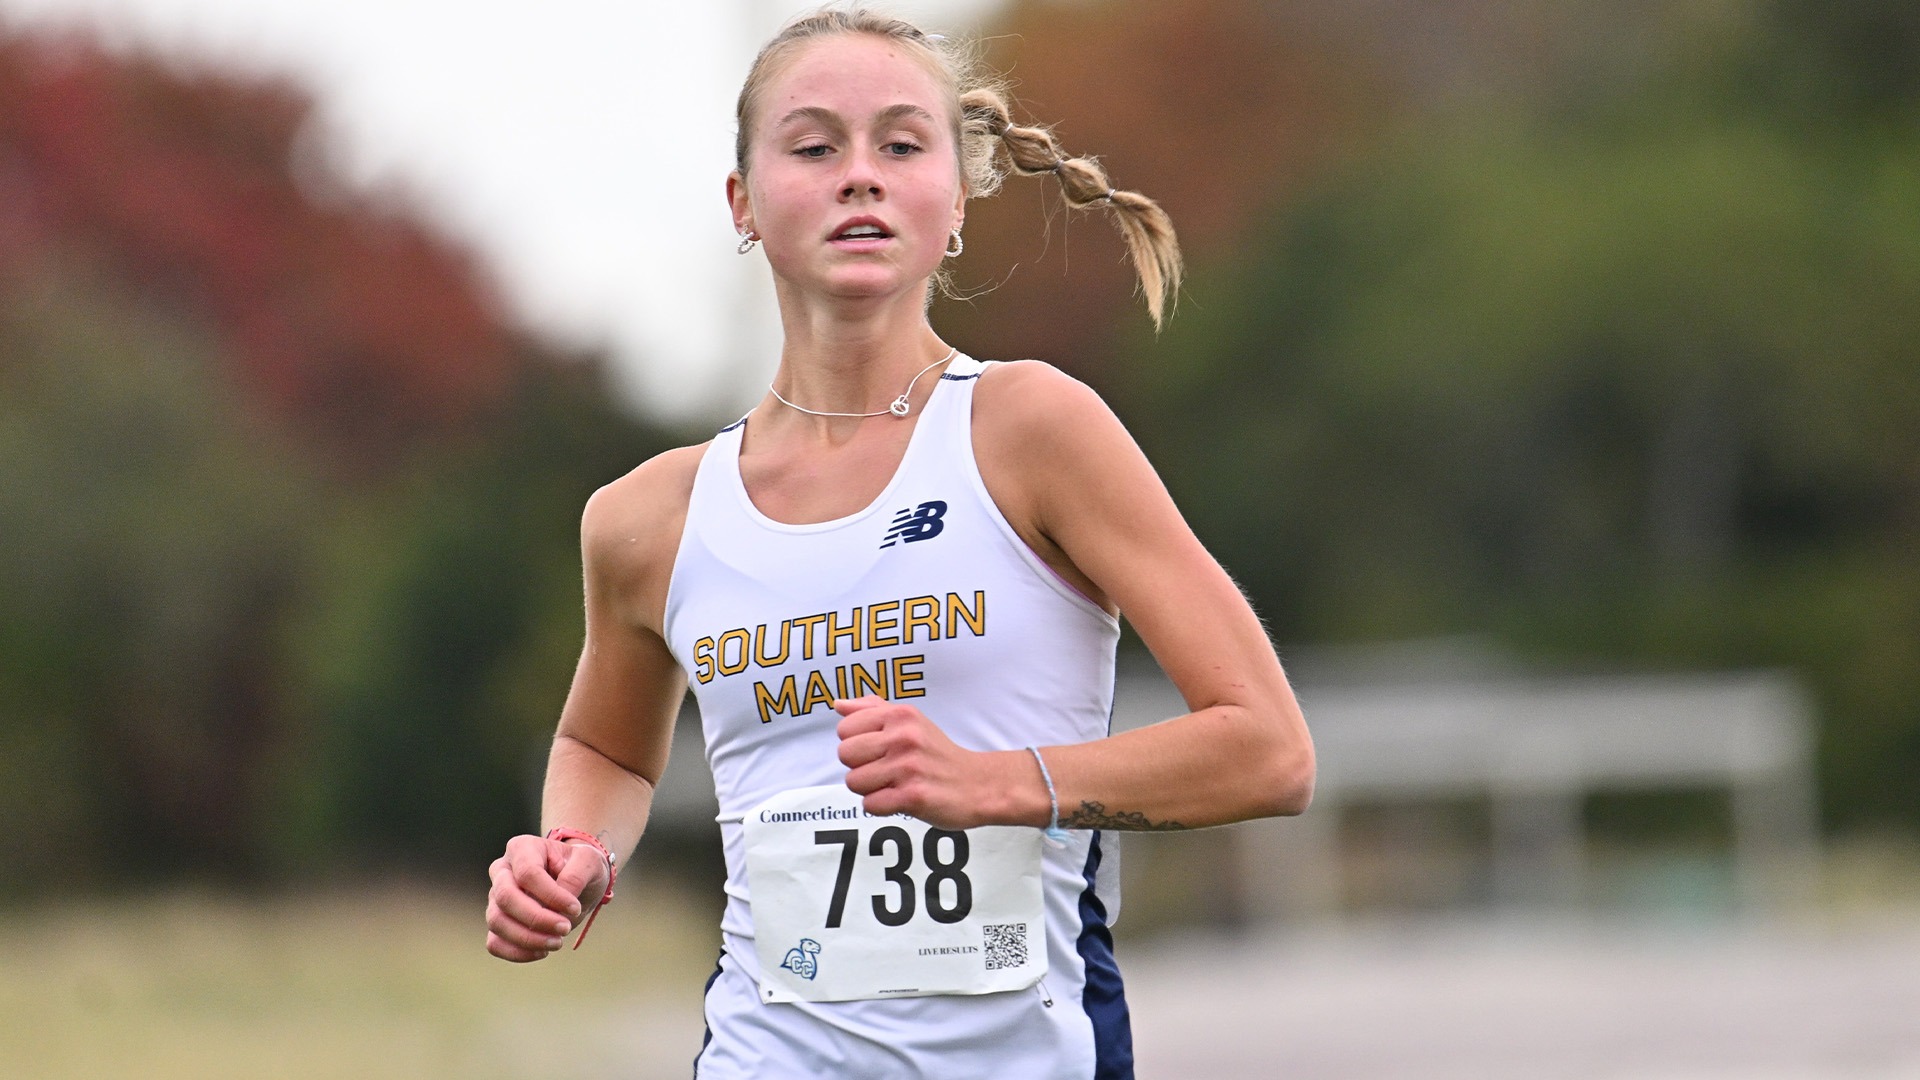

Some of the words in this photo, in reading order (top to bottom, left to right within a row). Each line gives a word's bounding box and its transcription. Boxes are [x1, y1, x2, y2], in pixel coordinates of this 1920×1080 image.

[879, 500, 948, 549] NB
[693, 590, 985, 684] SOUTHERN
[753, 654, 926, 723] MAINE
[760, 806, 858, 823] Connecticut
[814, 825, 973, 929] 738
[791, 956, 814, 979] CC
[918, 948, 939, 956] LIVE
[940, 946, 979, 955] RESULTS
